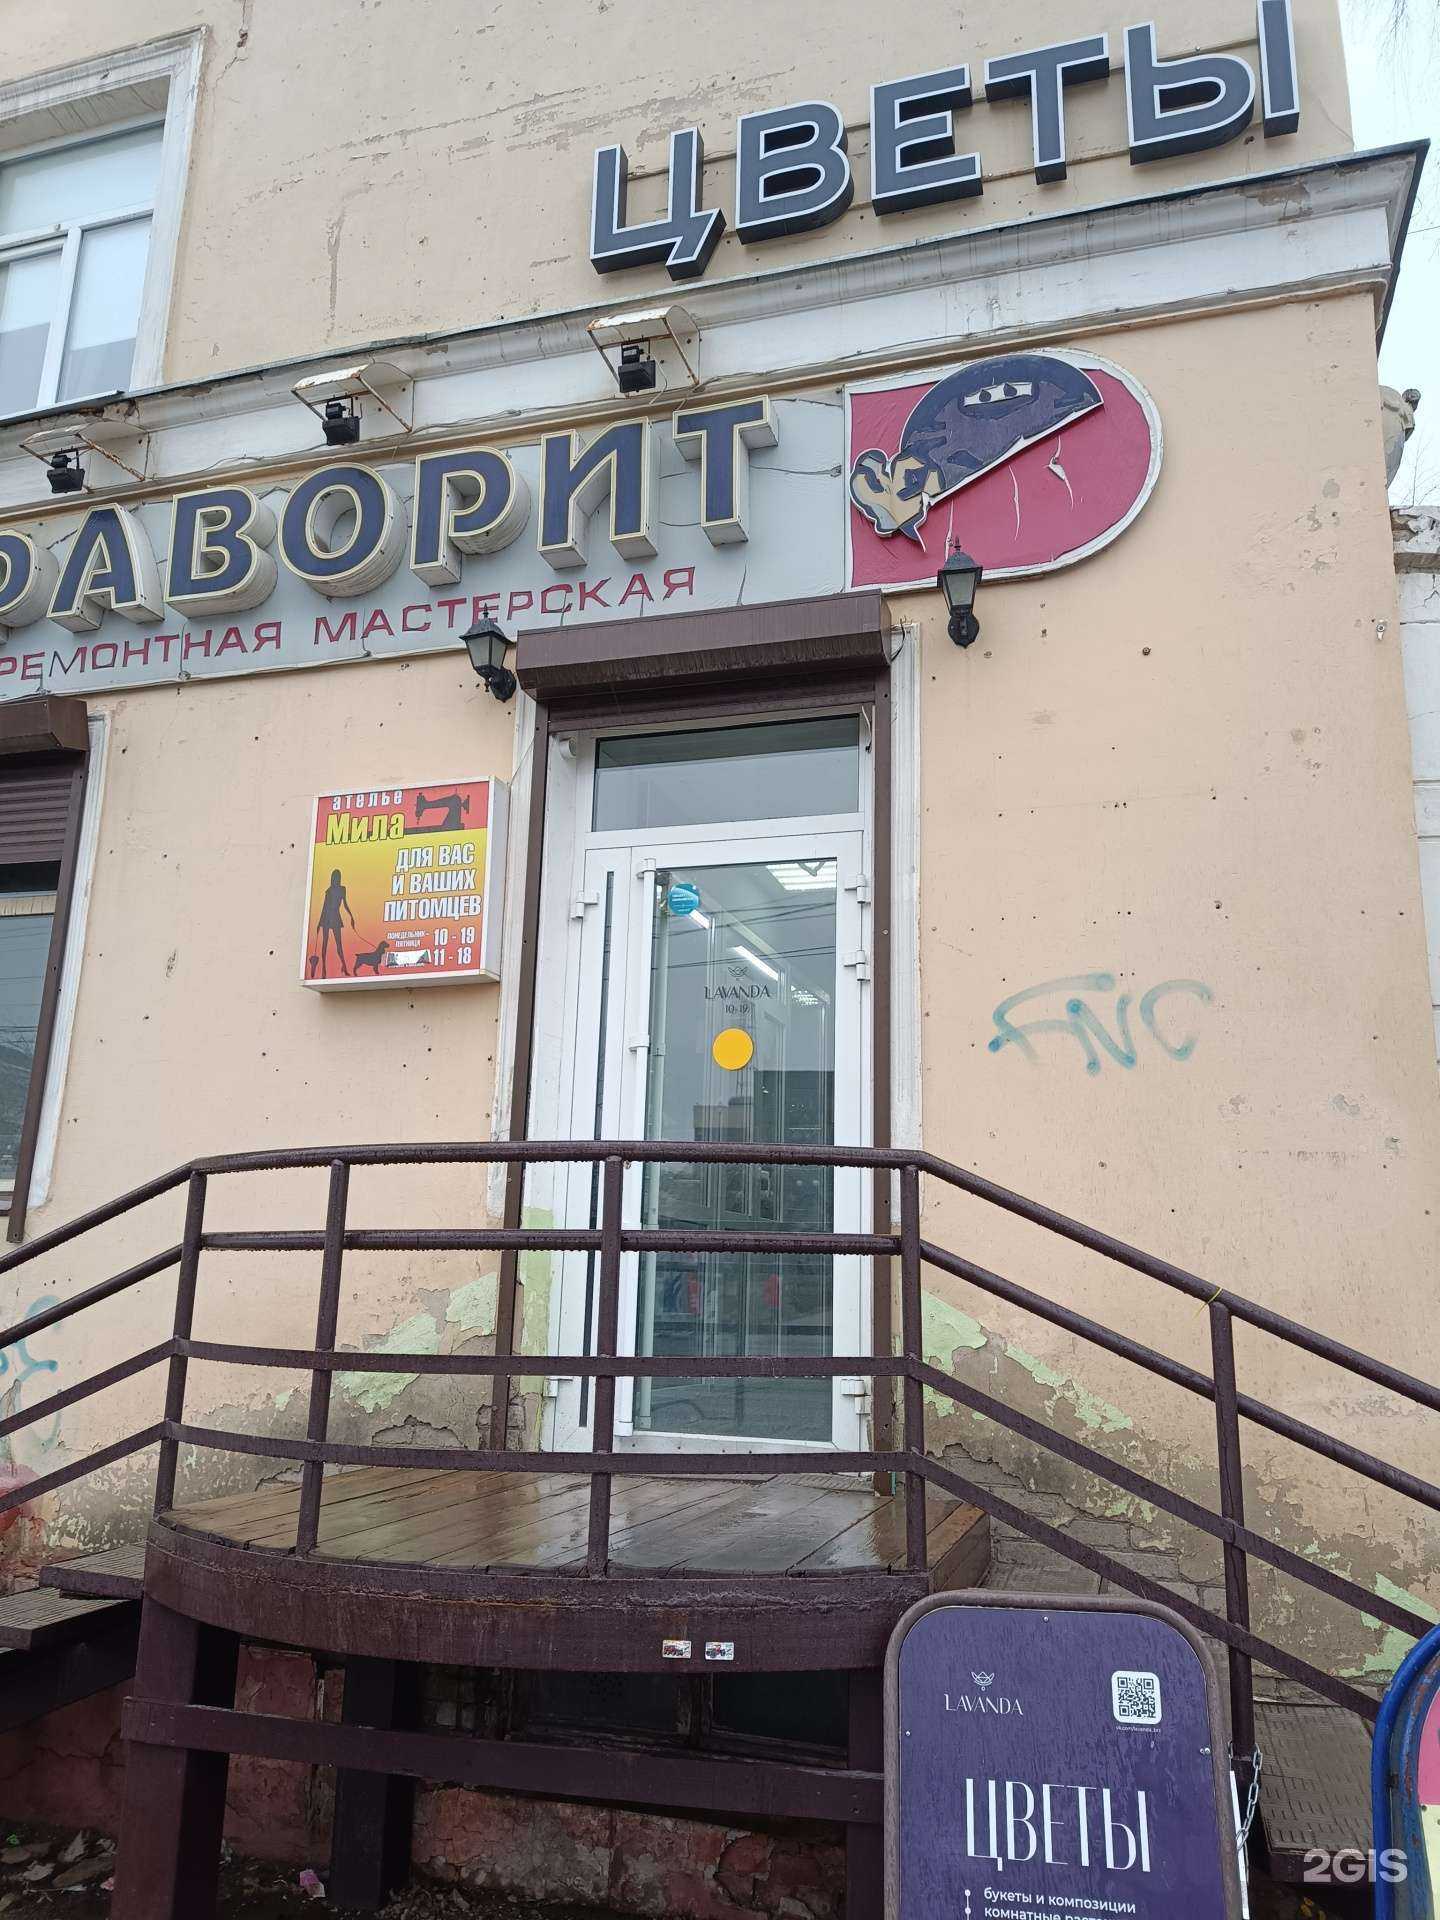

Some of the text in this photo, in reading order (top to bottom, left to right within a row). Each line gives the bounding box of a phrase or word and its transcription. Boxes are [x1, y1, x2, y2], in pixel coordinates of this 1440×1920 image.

[590, 0, 1300, 281] ЦВЕТЫ
[314, 566, 696, 645] МАСТЕРСКАЯ
[332, 790, 403, 811] ателье
[326, 812, 405, 845] Мила
[395, 843, 475, 873] ДЛЯ ВАС
[391, 869, 476, 896] И ВАШИХ
[383, 895, 482, 922] ПИТОМЦЕВ
[434, 928, 448, 946] 10
[460, 926, 475, 944] 19
[434, 948, 446, 966] 11
[457, 947, 472, 965] 18
[704, 985, 770, 1000] LAVANDA
[944, 1693, 1024, 1716] LAVANDA
[966, 1778, 1151, 1873] ЦВЕТЫ
[984, 1887, 1136, 1914] букеты и композиции
